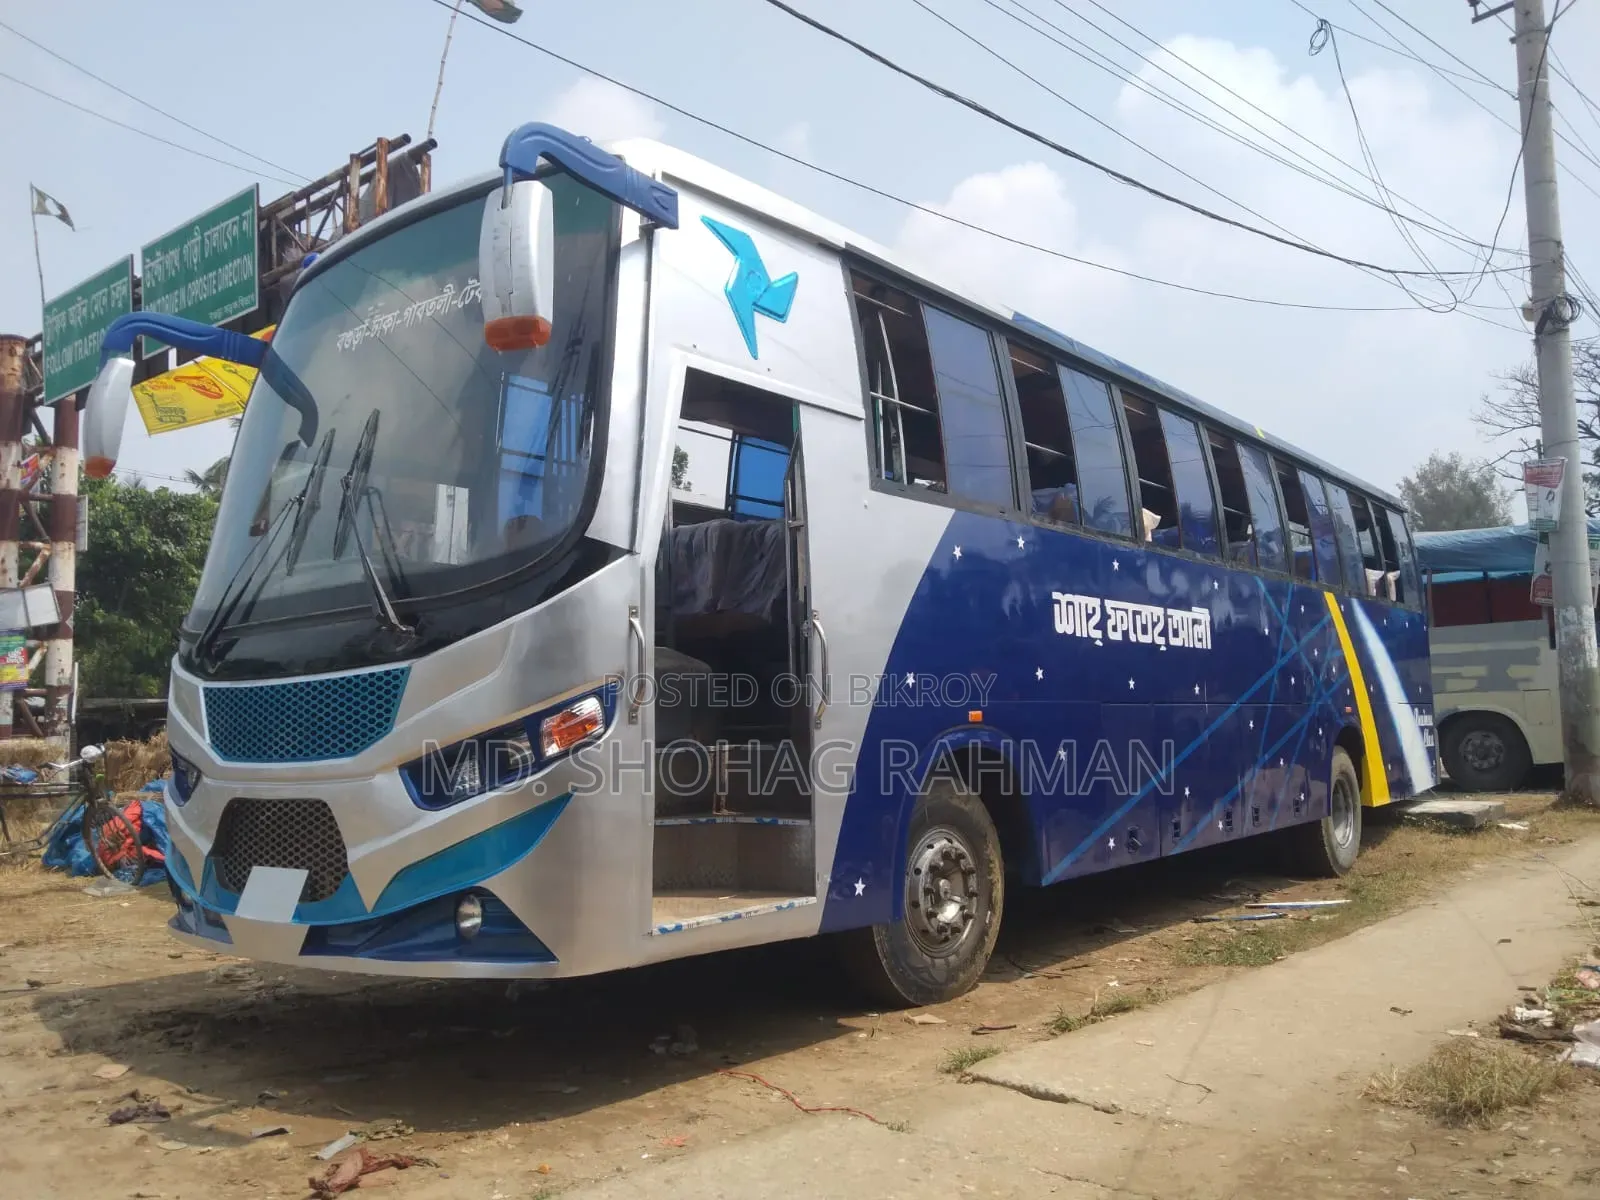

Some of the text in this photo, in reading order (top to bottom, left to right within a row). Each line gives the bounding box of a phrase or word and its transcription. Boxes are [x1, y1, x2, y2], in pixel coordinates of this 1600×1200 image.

[203, 215, 240, 258] চালাবেন
[242, 206, 253, 238] না
[68, 296, 89, 328] আইন
[90, 287, 109, 319] মেনে
[110, 276, 129, 309] চলুন
[187, 270, 217, 307] OPPOSITE
[218, 253, 253, 292] DIRECTION
[46, 347, 74, 378] FOLLOW
[1166, 606, 1212, 650] আলী
